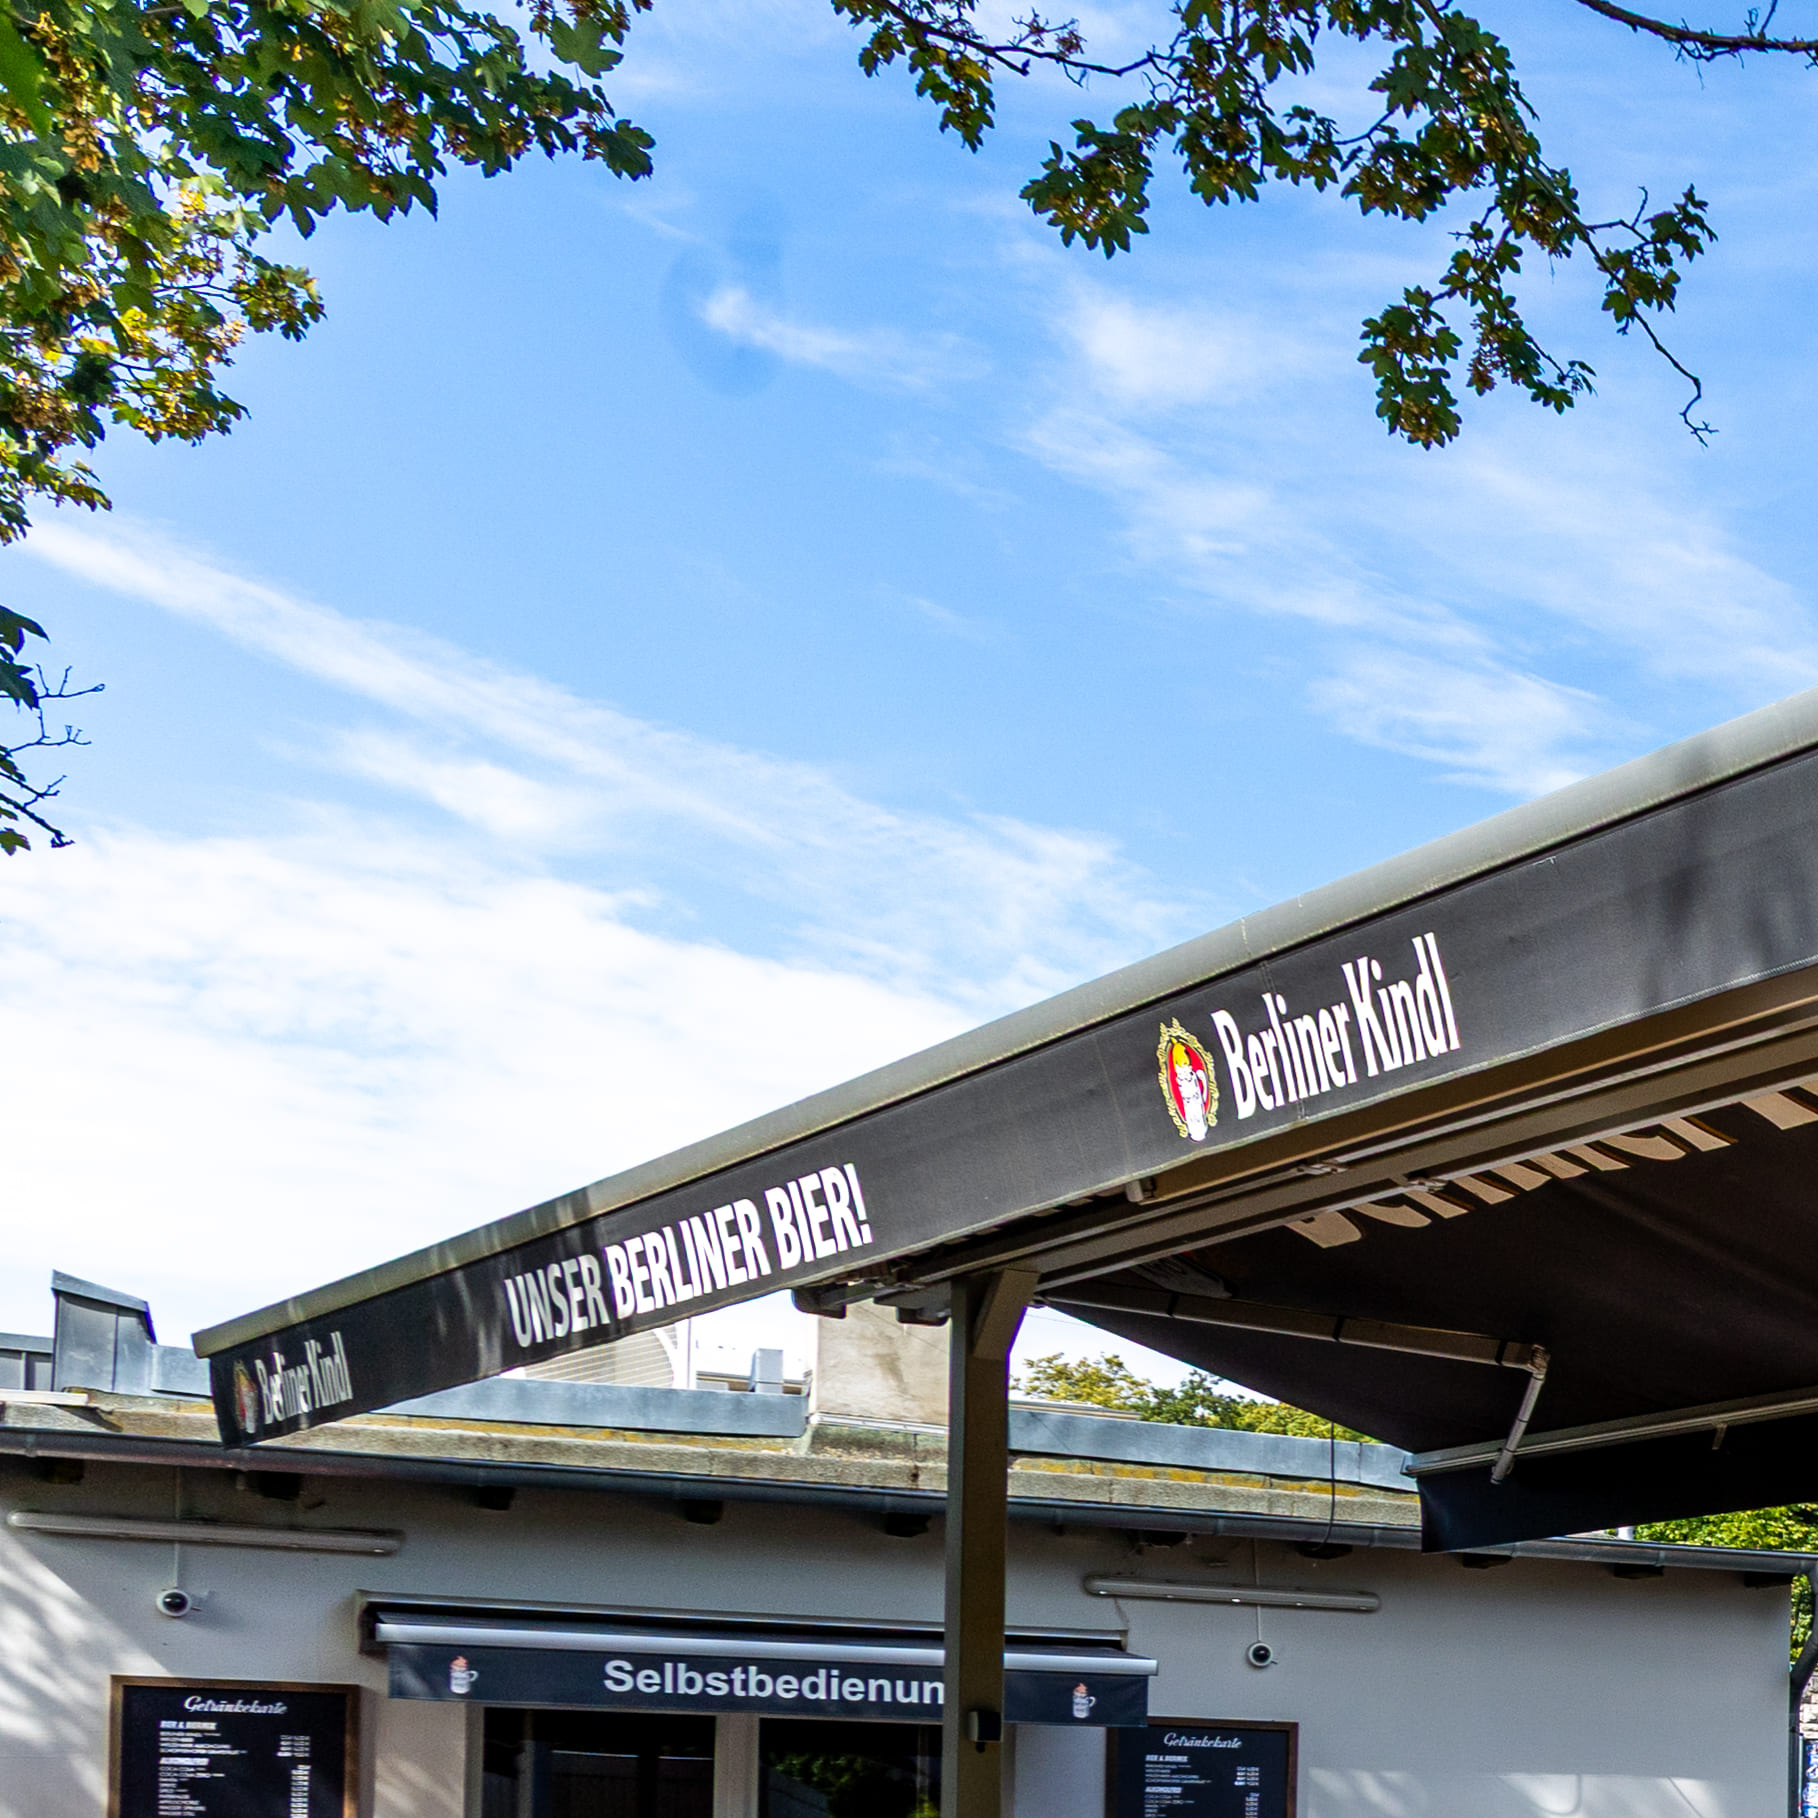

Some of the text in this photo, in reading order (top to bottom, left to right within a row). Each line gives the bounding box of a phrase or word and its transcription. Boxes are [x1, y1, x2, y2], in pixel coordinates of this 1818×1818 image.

[1211, 932, 1462, 1120] Berliner Kindl
[504, 1163, 872, 1348] UNSER BERLINER BIER!
[255, 1331, 353, 1425] Berliner Kindl
[184, 1695, 288, 1715] Getränkekarte
[603, 1659, 945, 1705] Selbstbedienun
[1163, 1732, 1243, 1748] Getränkekarte
